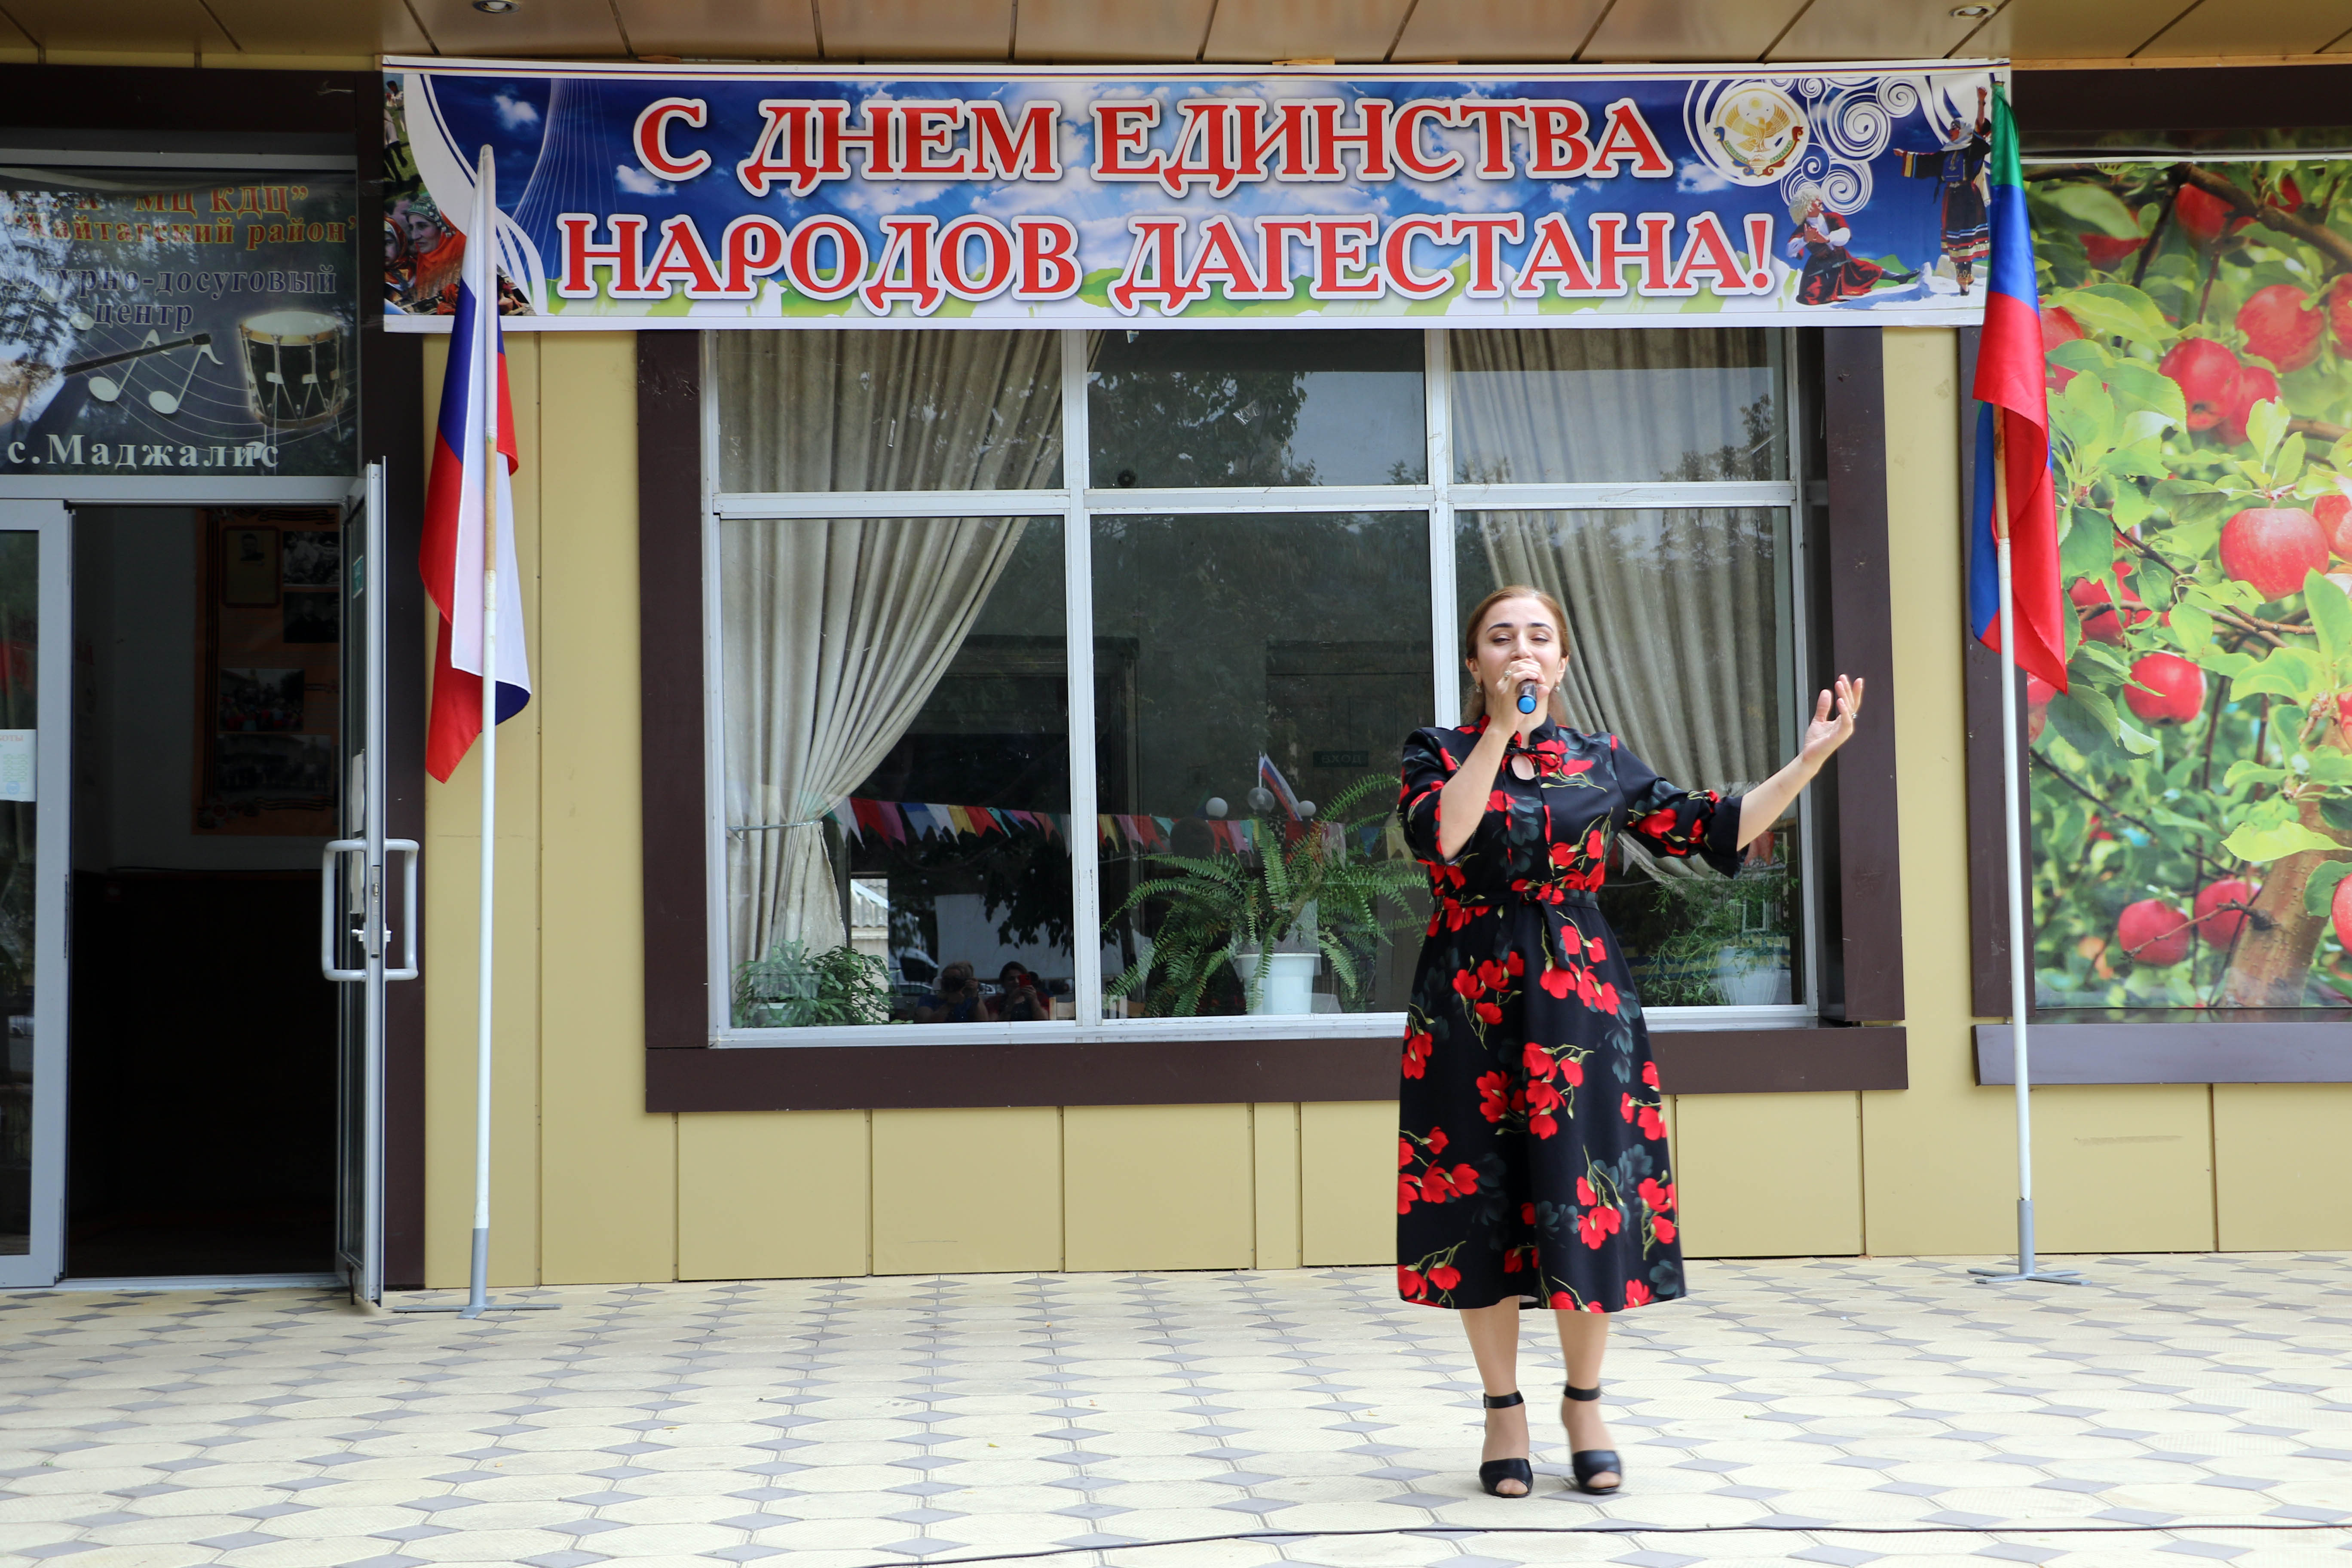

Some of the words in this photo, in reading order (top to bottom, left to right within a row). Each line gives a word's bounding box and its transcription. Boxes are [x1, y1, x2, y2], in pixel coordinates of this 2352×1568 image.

[642, 105, 711, 174] С
[745, 106, 1060, 190] ДНЕМ
[1097, 104, 1671, 190] ЕДИНСТВА
[118, 192, 198, 219] МЦ
[210, 186, 309, 220] КДЦ”
[565, 221, 1076, 309] НАРОДОВ
[1114, 218, 1770, 309] ДАГЕСТАНА!
[94, 303, 193, 334] центр
[7, 434, 279, 470] с.Маджалис
[1321, 754, 1362, 765] ВХОД
